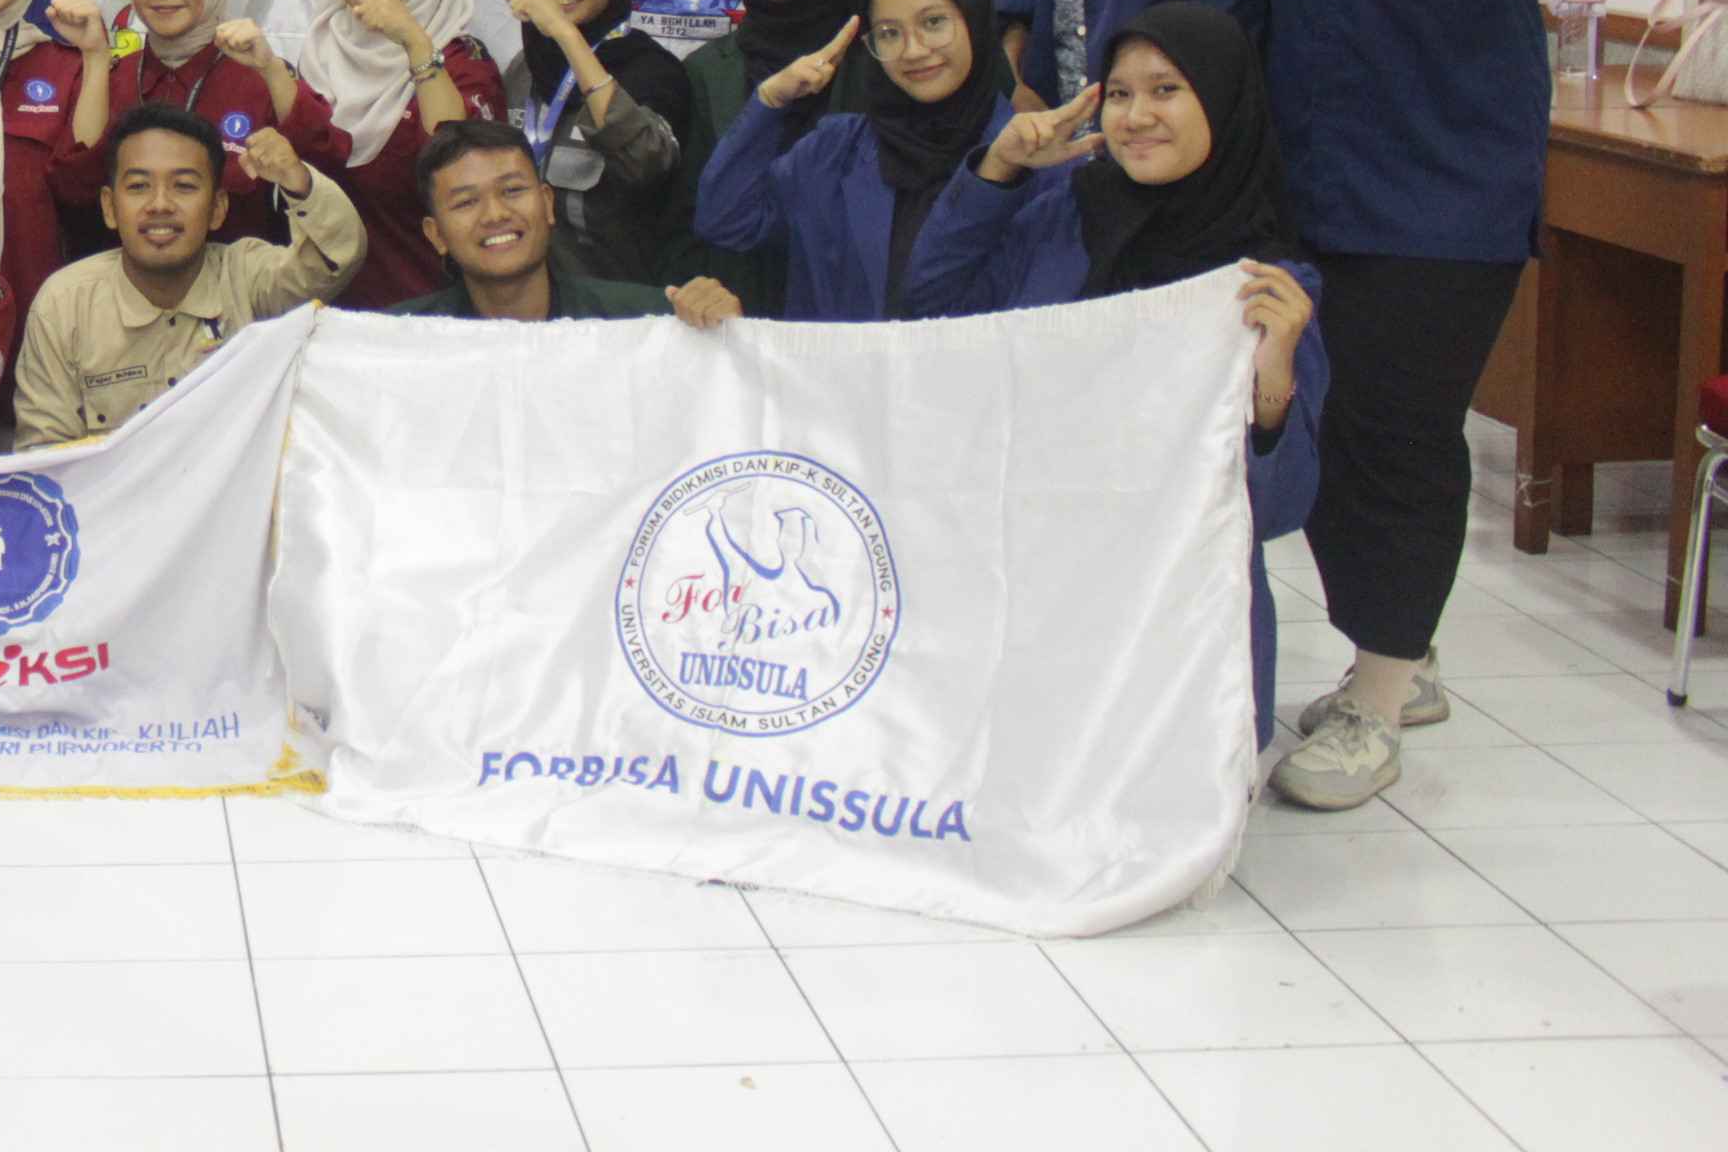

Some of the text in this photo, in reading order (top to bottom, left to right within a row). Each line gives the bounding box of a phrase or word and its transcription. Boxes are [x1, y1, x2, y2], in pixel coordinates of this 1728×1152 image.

[630, 458, 893, 593] FORUM BIDIKMISI DAN KIP-K SULTAN AGUNG
[622, 604, 886, 730] UNIVERSITAS ISLAM SULTAN AGUNG
[679, 652, 809, 701] UNISSULA
[138, 711, 240, 740] KULIAH
[702, 760, 973, 842] UNISSULA
